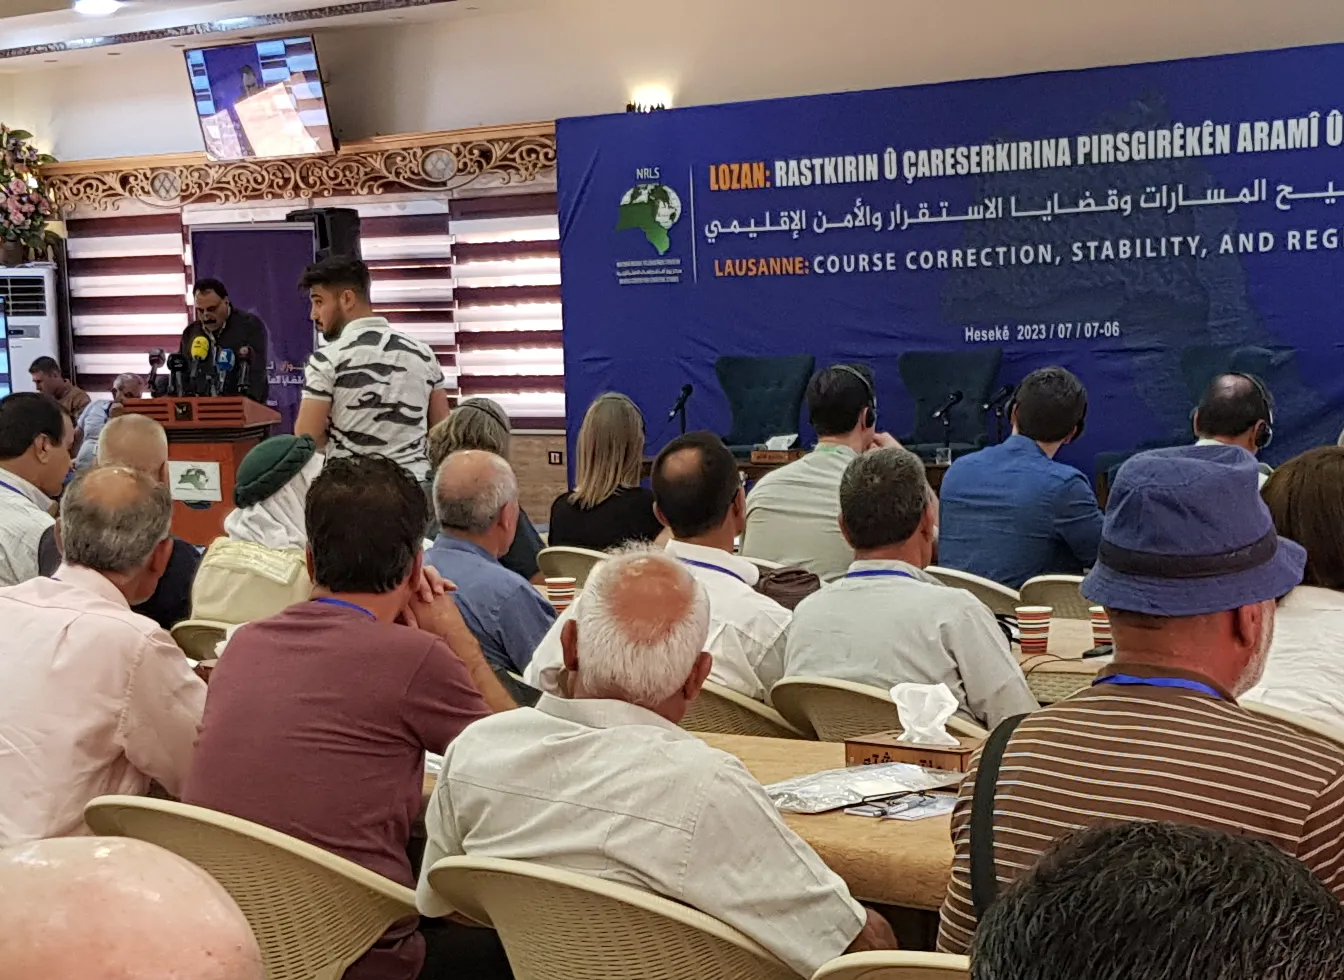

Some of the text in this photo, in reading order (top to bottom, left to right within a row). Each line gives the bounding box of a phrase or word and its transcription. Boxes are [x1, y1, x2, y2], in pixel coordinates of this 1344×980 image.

[709, 162, 771, 191] LOZAN:
[774, 154, 879, 188] RASTKIRIN
[884, 147, 898, 181] Û
[903, 137, 1072, 184] ÇARESERKIRINA
[1077, 119, 1231, 165] PIRSGIRÊKÊN
[1236, 110, 1321, 153] ARAMÎ
[1326, 109, 1343, 147] Û
[636, 167, 660, 179] NRLS
[1010, 189, 1132, 221] وقضايا
[1139, 178, 1267, 214] المسارات
[704, 209, 807, 244] الإقليمي
[812, 198, 882, 233] والأمن
[887, 197, 1004, 231] الاستقرار
[714, 257, 810, 278] LAUSANNE:
[813, 252, 897, 275] COURSE
[906, 244, 1061, 270] CORRECTION,
[1072, 235, 1208, 262] STABILITY,
[1219, 232, 1274, 255] AND
[1017, 324, 1046, 340] 2023
[1058, 323, 1072, 339] 07
[1084, 321, 1120, 338] 07-06
